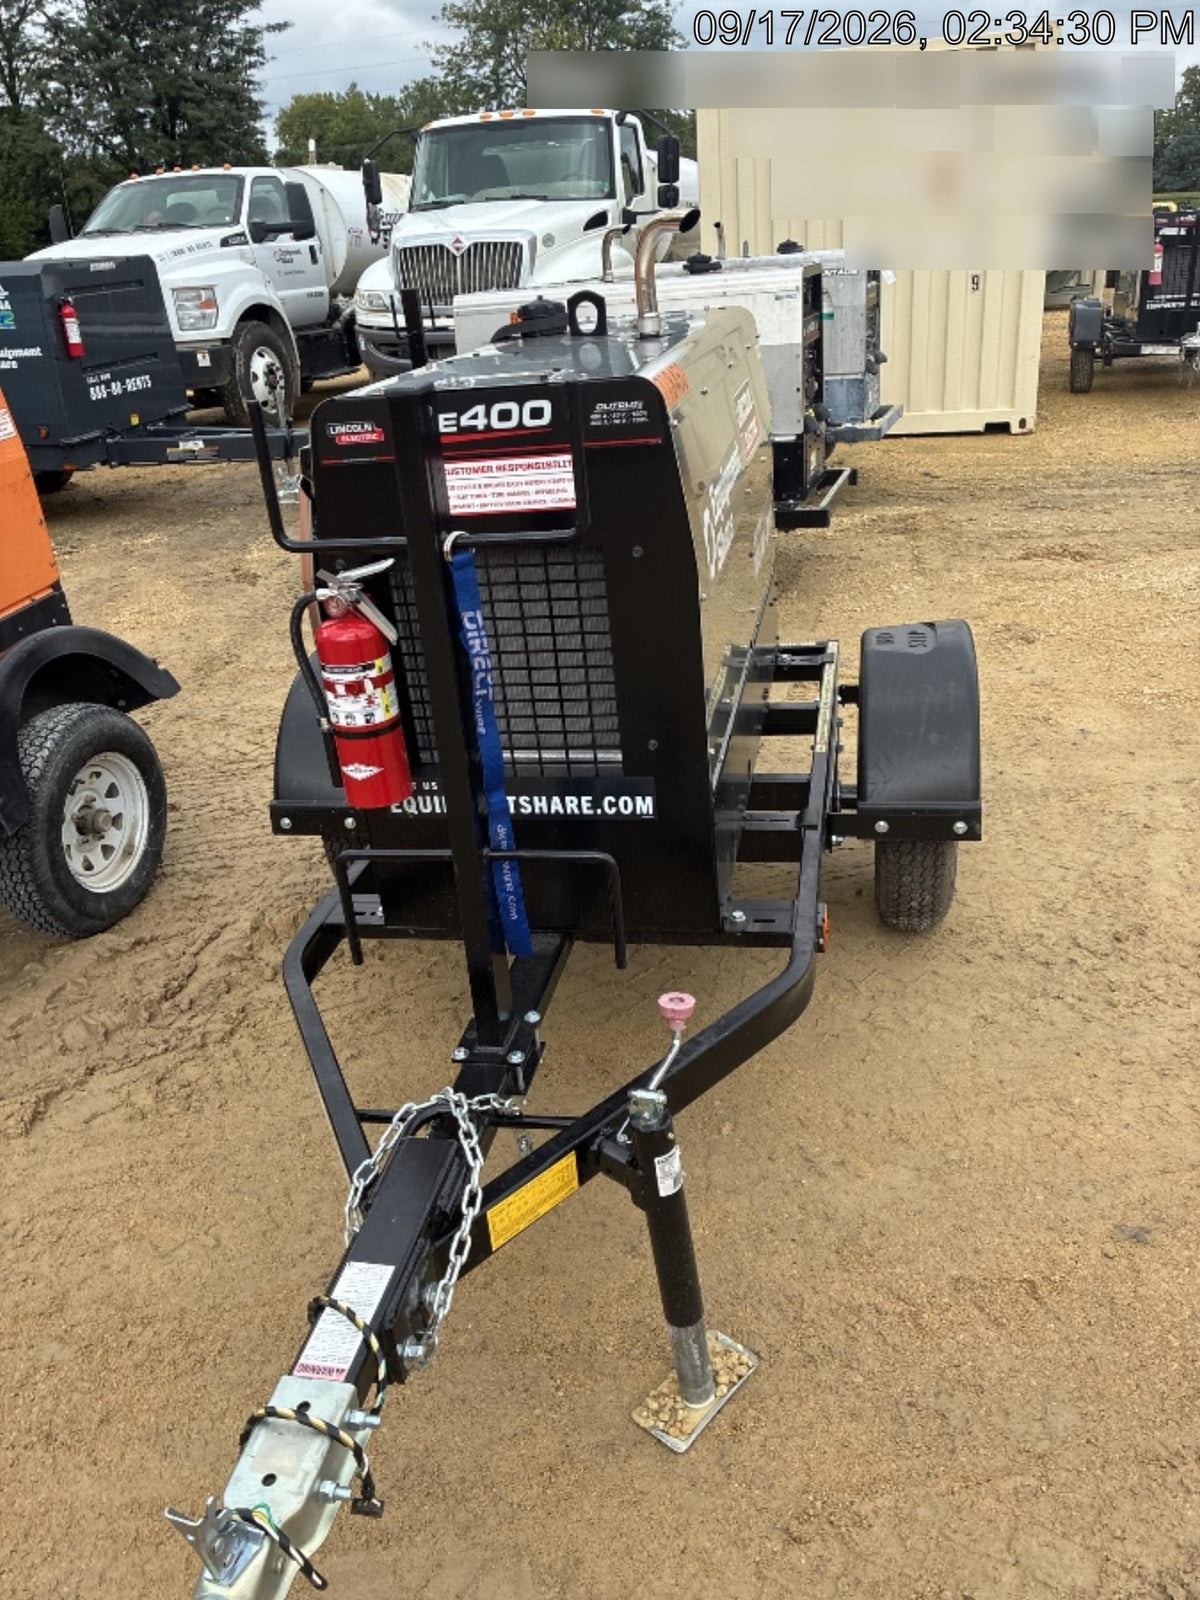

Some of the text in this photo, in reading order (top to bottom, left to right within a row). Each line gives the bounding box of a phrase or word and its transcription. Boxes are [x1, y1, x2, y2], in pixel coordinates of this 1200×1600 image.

[329, 423, 373, 435] LINCOLN
[339, 432, 379, 442] ELECTRIC
[462, 609, 494, 701] DIRECT
[422, 781, 439, 791] US
